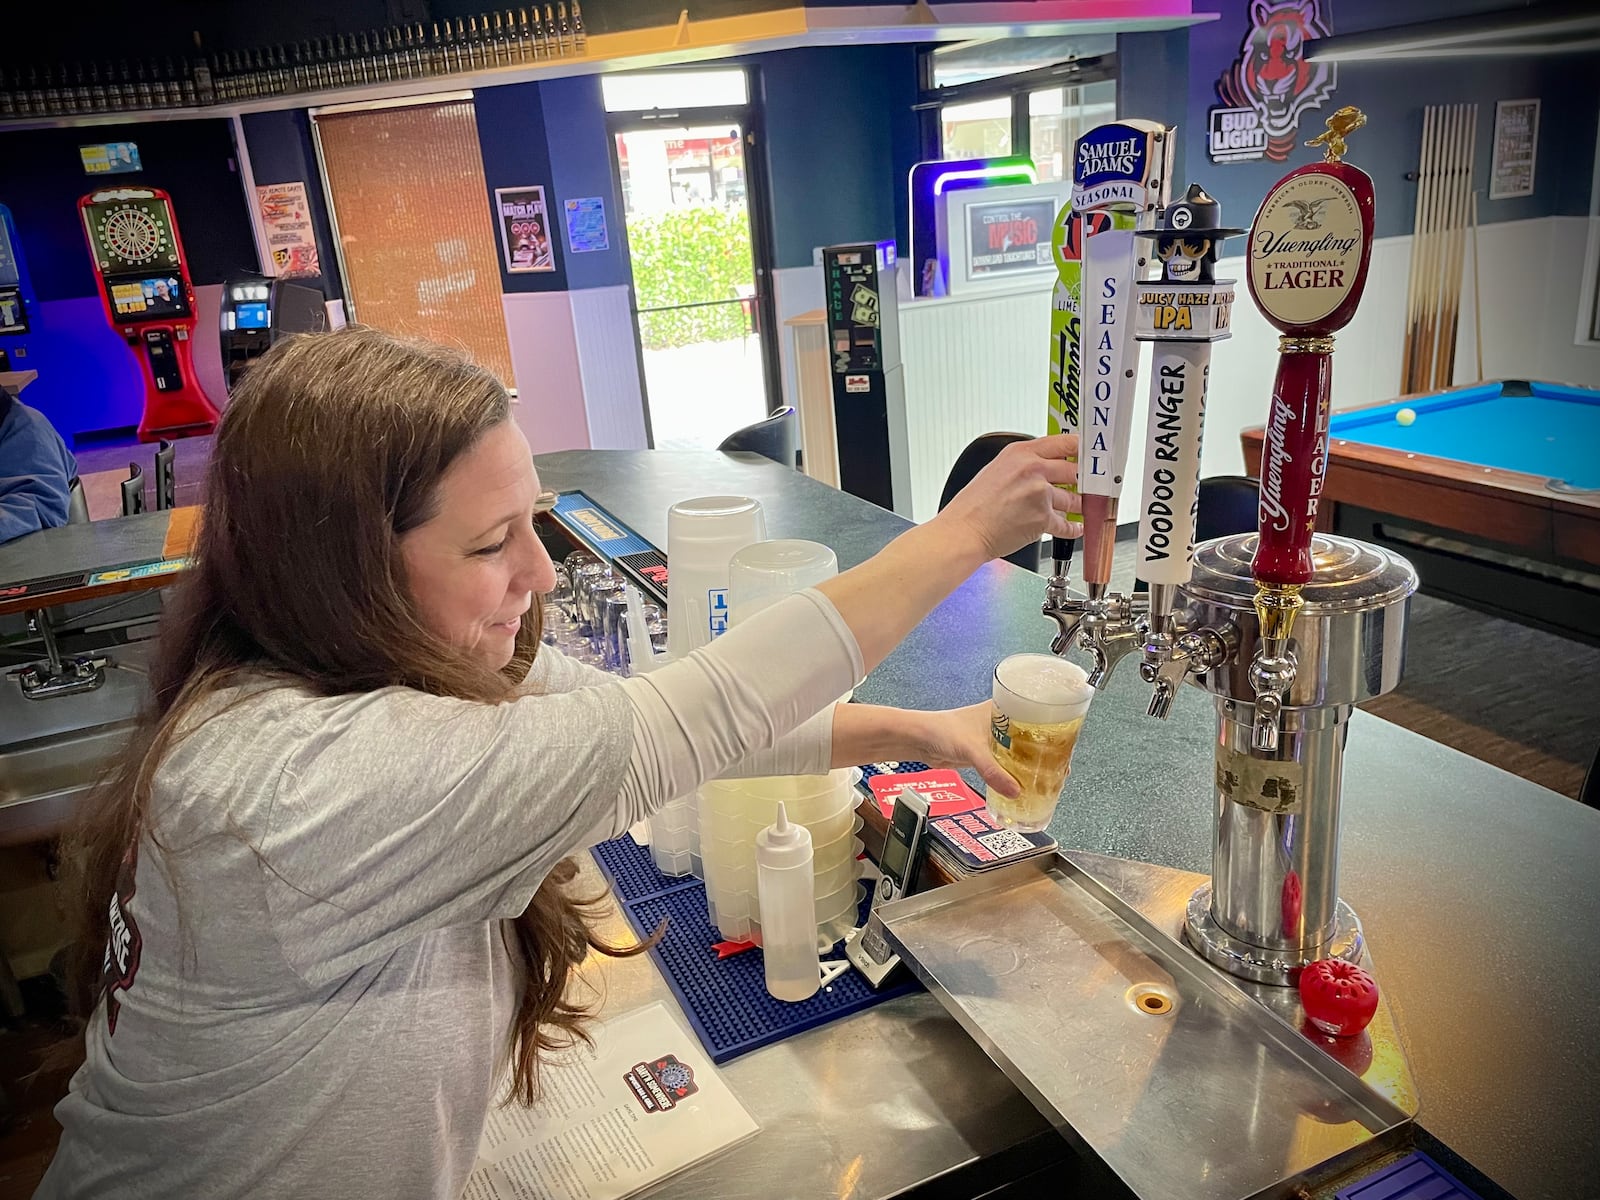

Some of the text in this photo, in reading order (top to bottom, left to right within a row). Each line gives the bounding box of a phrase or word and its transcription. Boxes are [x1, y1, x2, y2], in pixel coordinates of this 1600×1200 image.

[1221, 111, 1259, 131] BUD
[1079, 138, 1142, 163] SAMUEL
[1214, 128, 1264, 149] LIGHT
[1080, 156, 1137, 180] ADAMS
[1075, 186, 1135, 207] SEASONAL
[983, 212, 1022, 224] CONTROL THE
[988, 217, 1037, 250] MUSIC
[1252, 228, 1361, 260] Yuengling
[1274, 259, 1340, 270] TRADITIONAL
[1264, 269, 1344, 290] LAGER
[1057, 300, 1078, 313] LIME
[1139, 292, 1175, 305] JUICY
[1177, 292, 1209, 305] HAZE
[1153, 305, 1192, 330] IPA
[1090, 277, 1116, 476] SEASONAL
[1154, 362, 1186, 462] RANGER
[1259, 393, 1297, 531] Yuengling
[1306, 414, 1327, 516] LAGER
[1145, 468, 1176, 561] VOODOO
